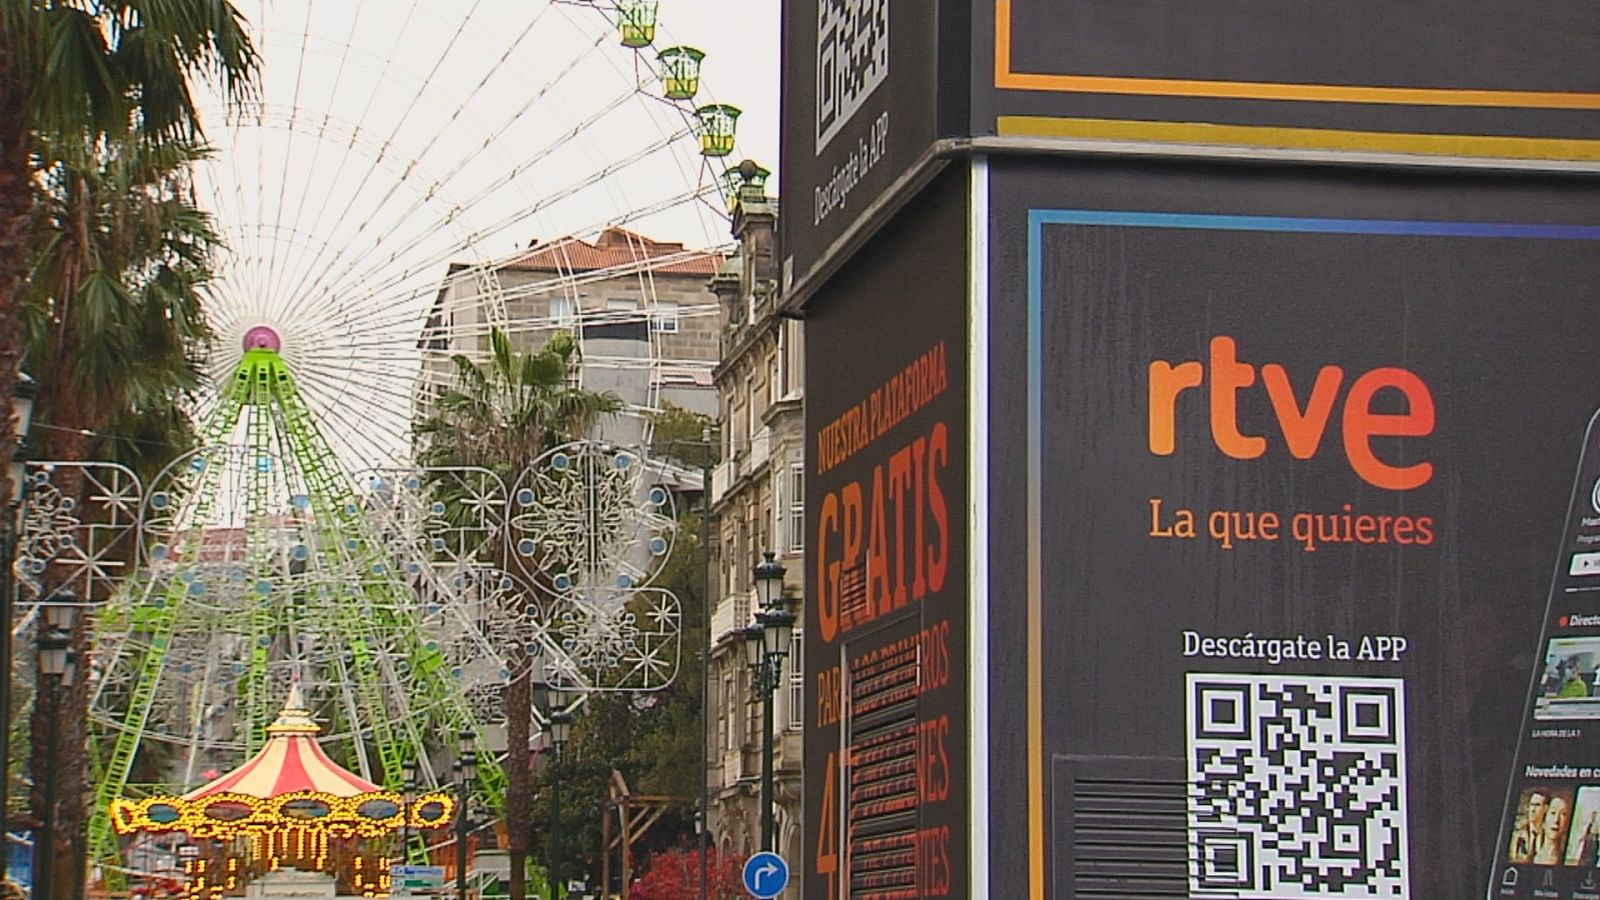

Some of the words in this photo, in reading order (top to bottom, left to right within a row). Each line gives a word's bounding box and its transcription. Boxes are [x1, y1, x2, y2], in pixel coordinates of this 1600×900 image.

[814, 152, 858, 226] Descárgate
[860, 138, 868, 178] la
[869, 111, 888, 168] APP
[818, 405, 868, 475] NUESTRA
[870, 340, 947, 441] PLATAFORMA
[1148, 335, 1436, 491] rtve
[818, 422, 948, 642] GRATIS
[1149, 499, 1196, 538] La
[1208, 508, 1280, 549] que
[1291, 503, 1434, 551] quieres
[1183, 631, 1321, 665] Descárgate
[1327, 635, 1350, 660] la
[1356, 636, 1407, 661] APP
[1525, 765, 1577, 778] Novedades
[1579, 768, 1592, 778] en
